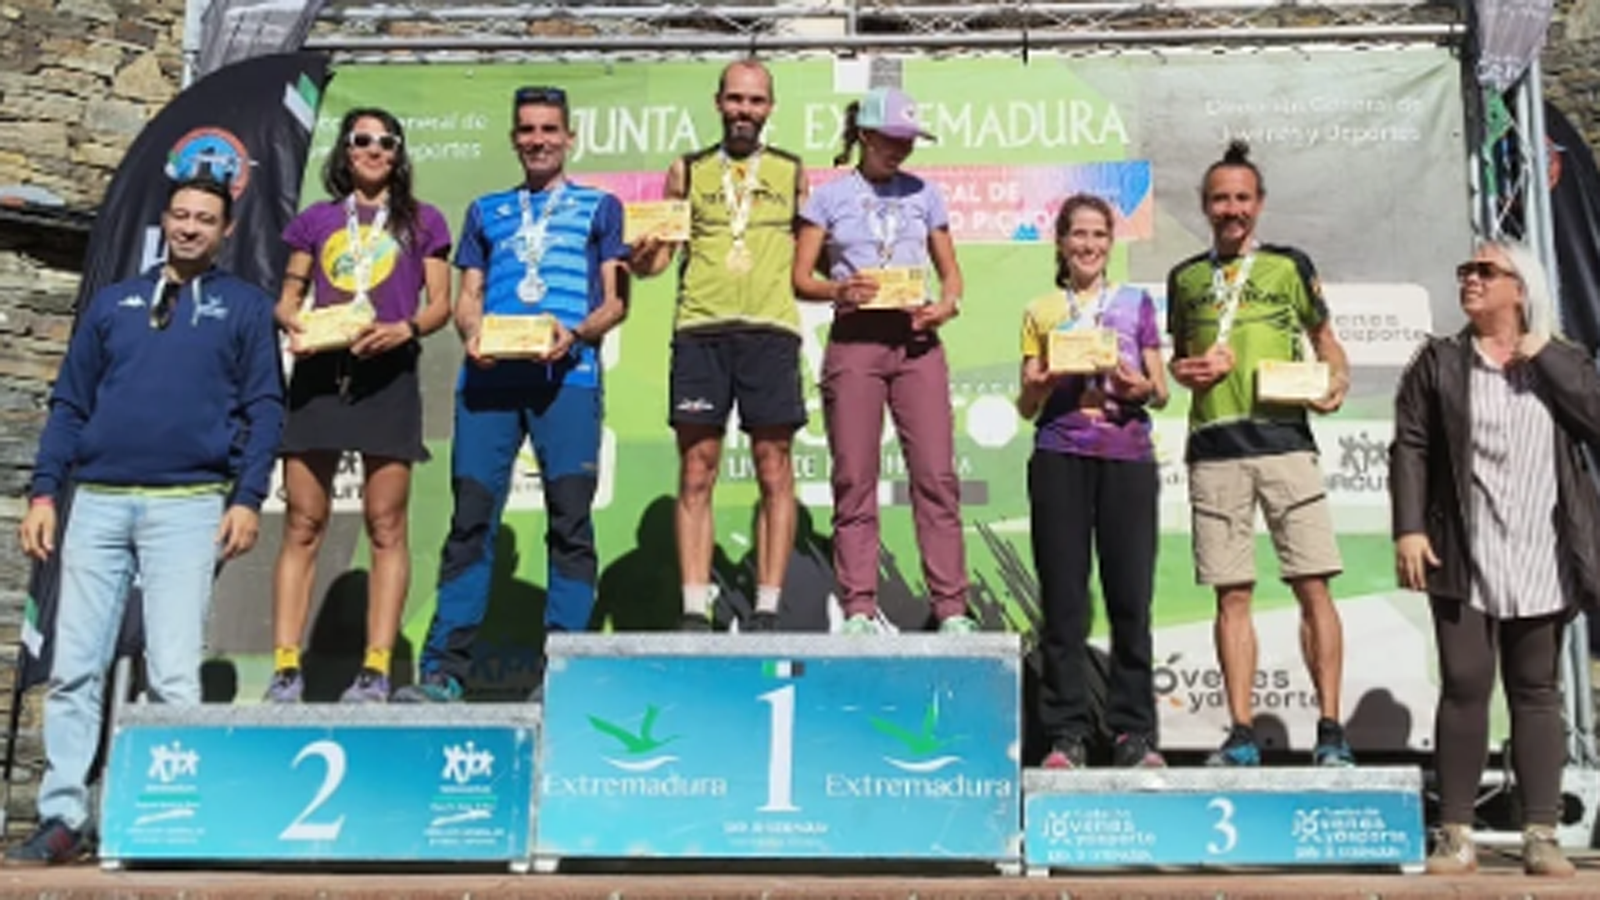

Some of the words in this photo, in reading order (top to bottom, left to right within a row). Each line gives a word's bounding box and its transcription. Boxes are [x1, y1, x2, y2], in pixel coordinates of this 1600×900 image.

[572, 105, 701, 162] JUNTA
[804, 97, 1129, 150] EXEMADURA
[756, 684, 801, 812] 1
[277, 740, 347, 842] 2
[541, 773, 728, 797] Extremadura
[825, 773, 1012, 798] Extremadura
[1205, 797, 1239, 856] 3
